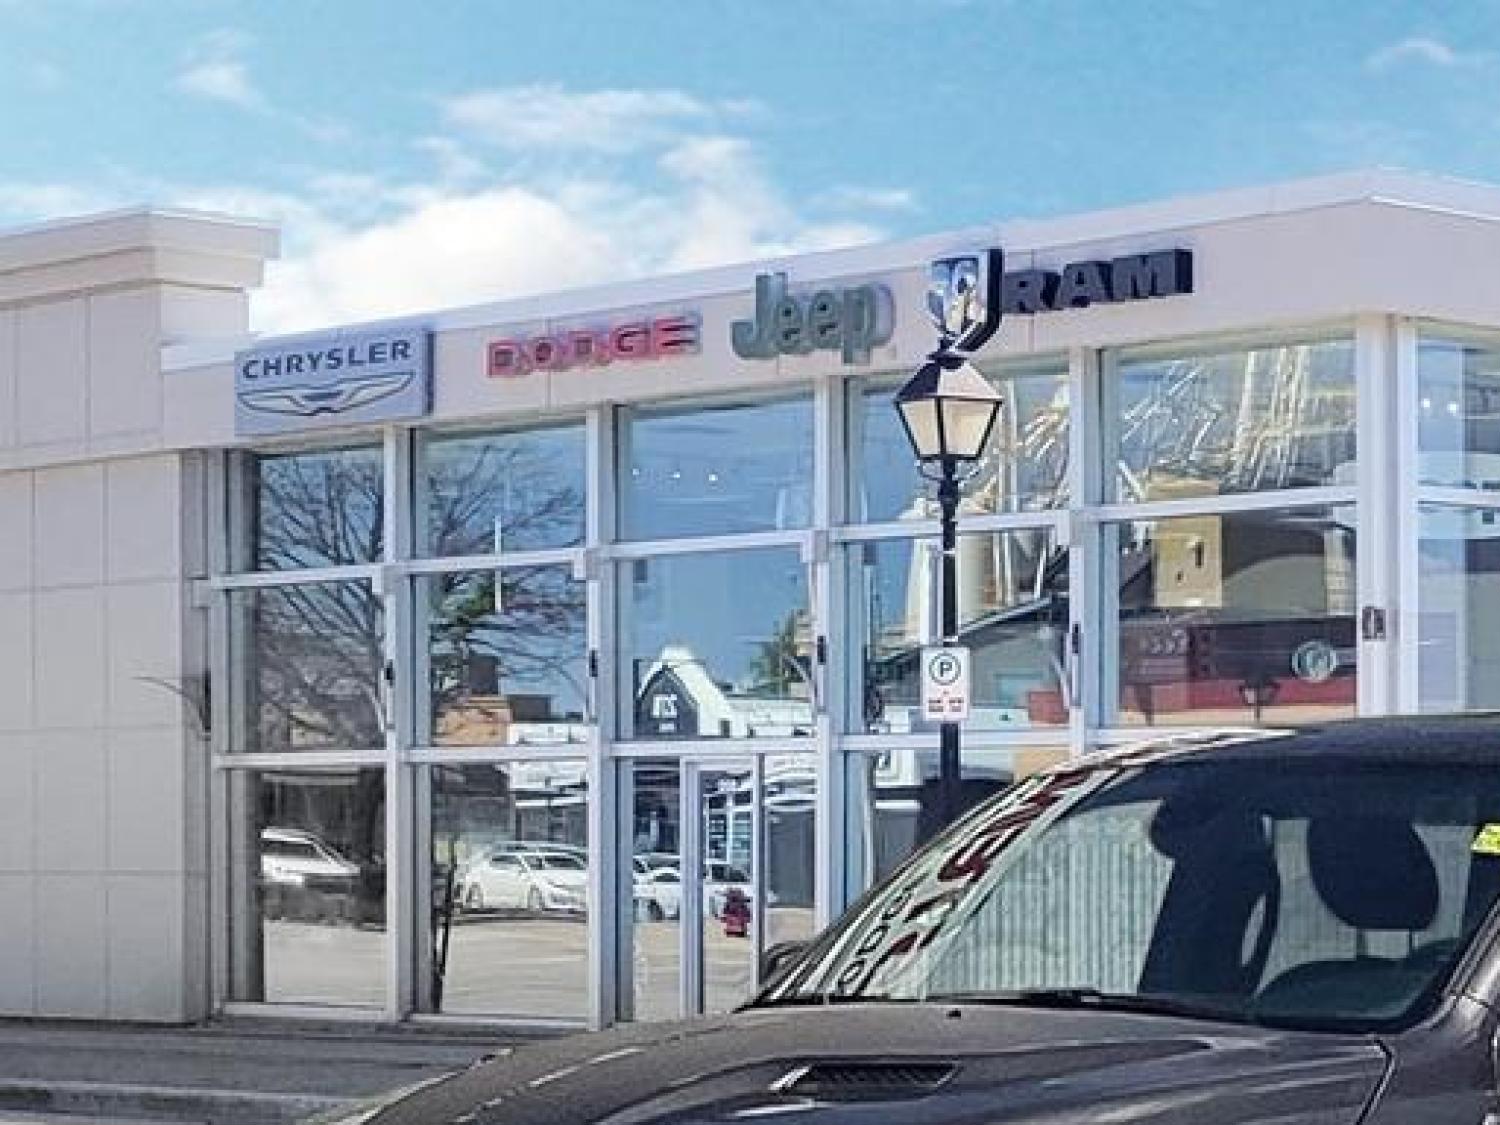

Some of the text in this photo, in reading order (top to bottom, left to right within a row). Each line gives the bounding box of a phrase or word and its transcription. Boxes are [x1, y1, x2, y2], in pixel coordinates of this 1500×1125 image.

[1002, 248, 1194, 315] RAM
[486, 316, 698, 378] DODGE
[732, 272, 894, 364] Jeep
[242, 339, 412, 379] CHRYSLER
